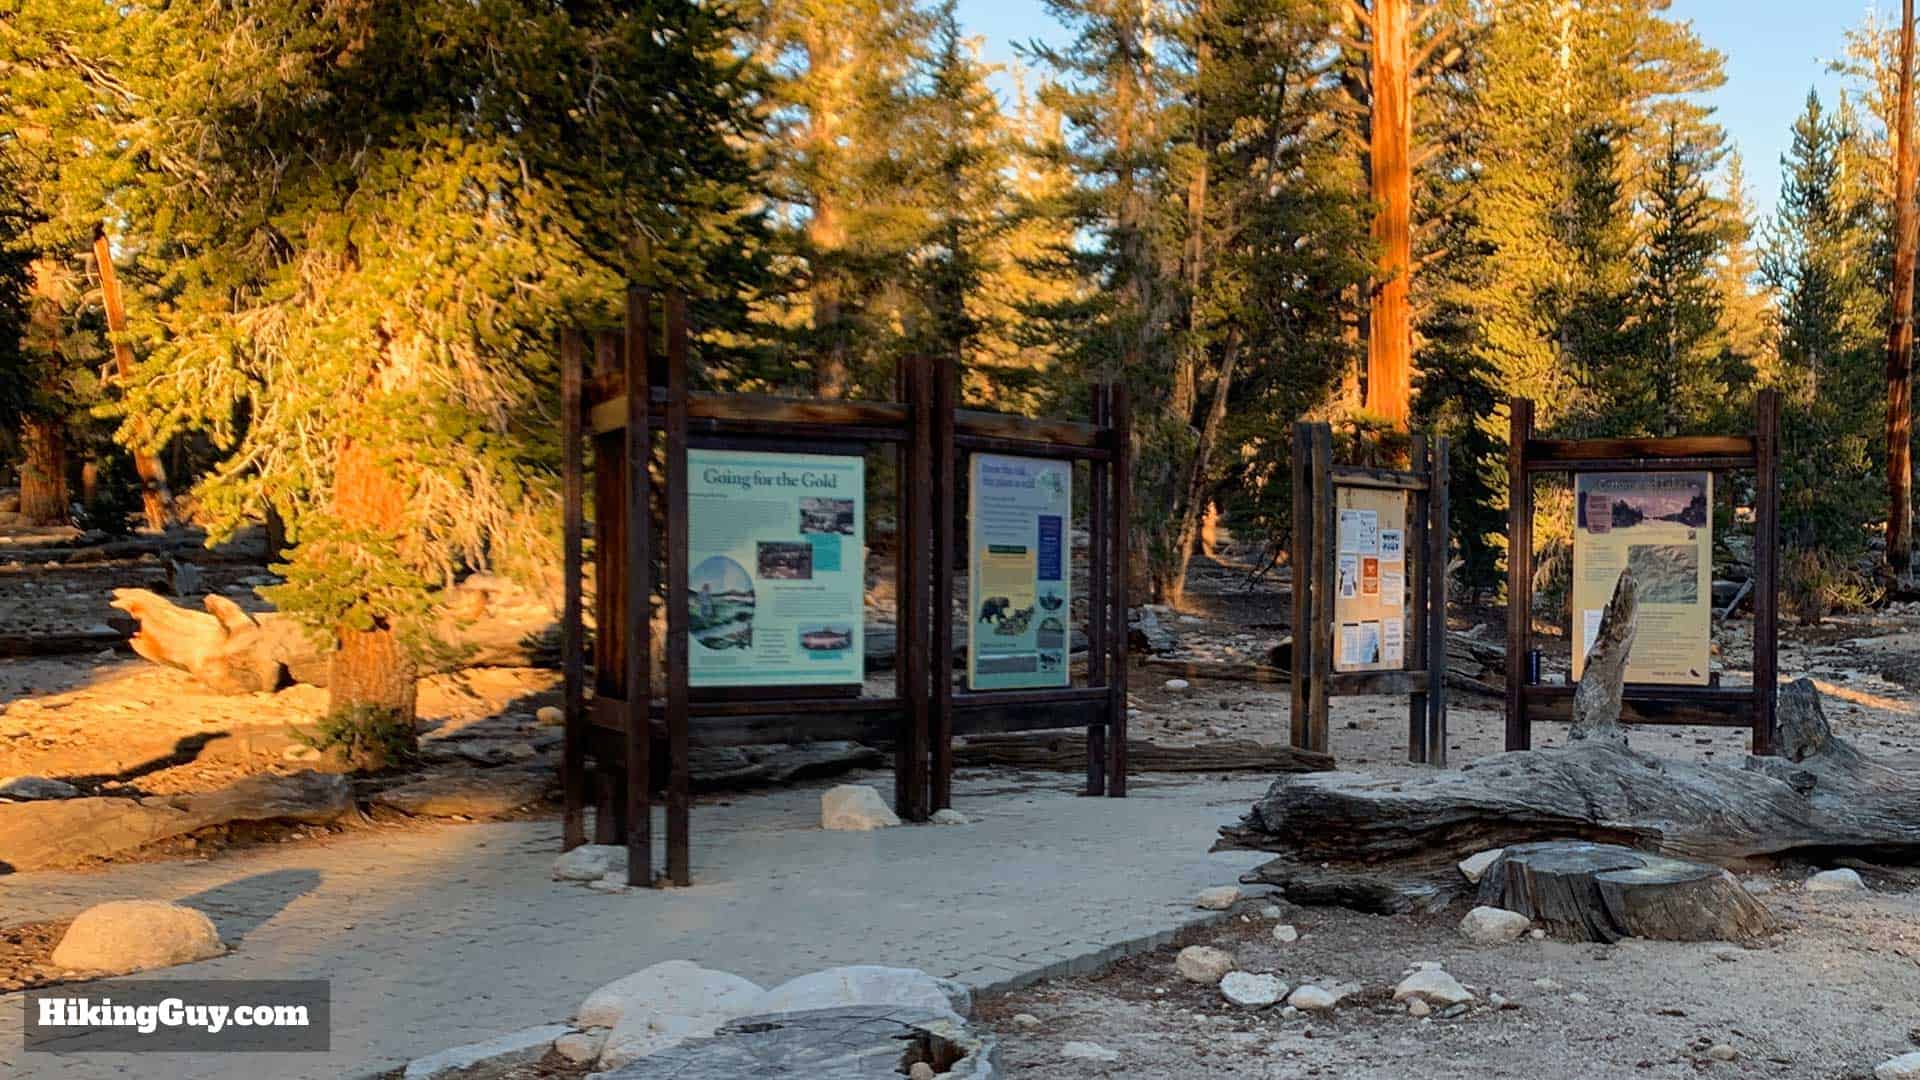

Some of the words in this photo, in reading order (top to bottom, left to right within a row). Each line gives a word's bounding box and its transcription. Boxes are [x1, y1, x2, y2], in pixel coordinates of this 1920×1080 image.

[703, 468, 751, 489] Going
[753, 470, 773, 486] for
[775, 472, 799, 487] the
[801, 472, 837, 488] Gold
